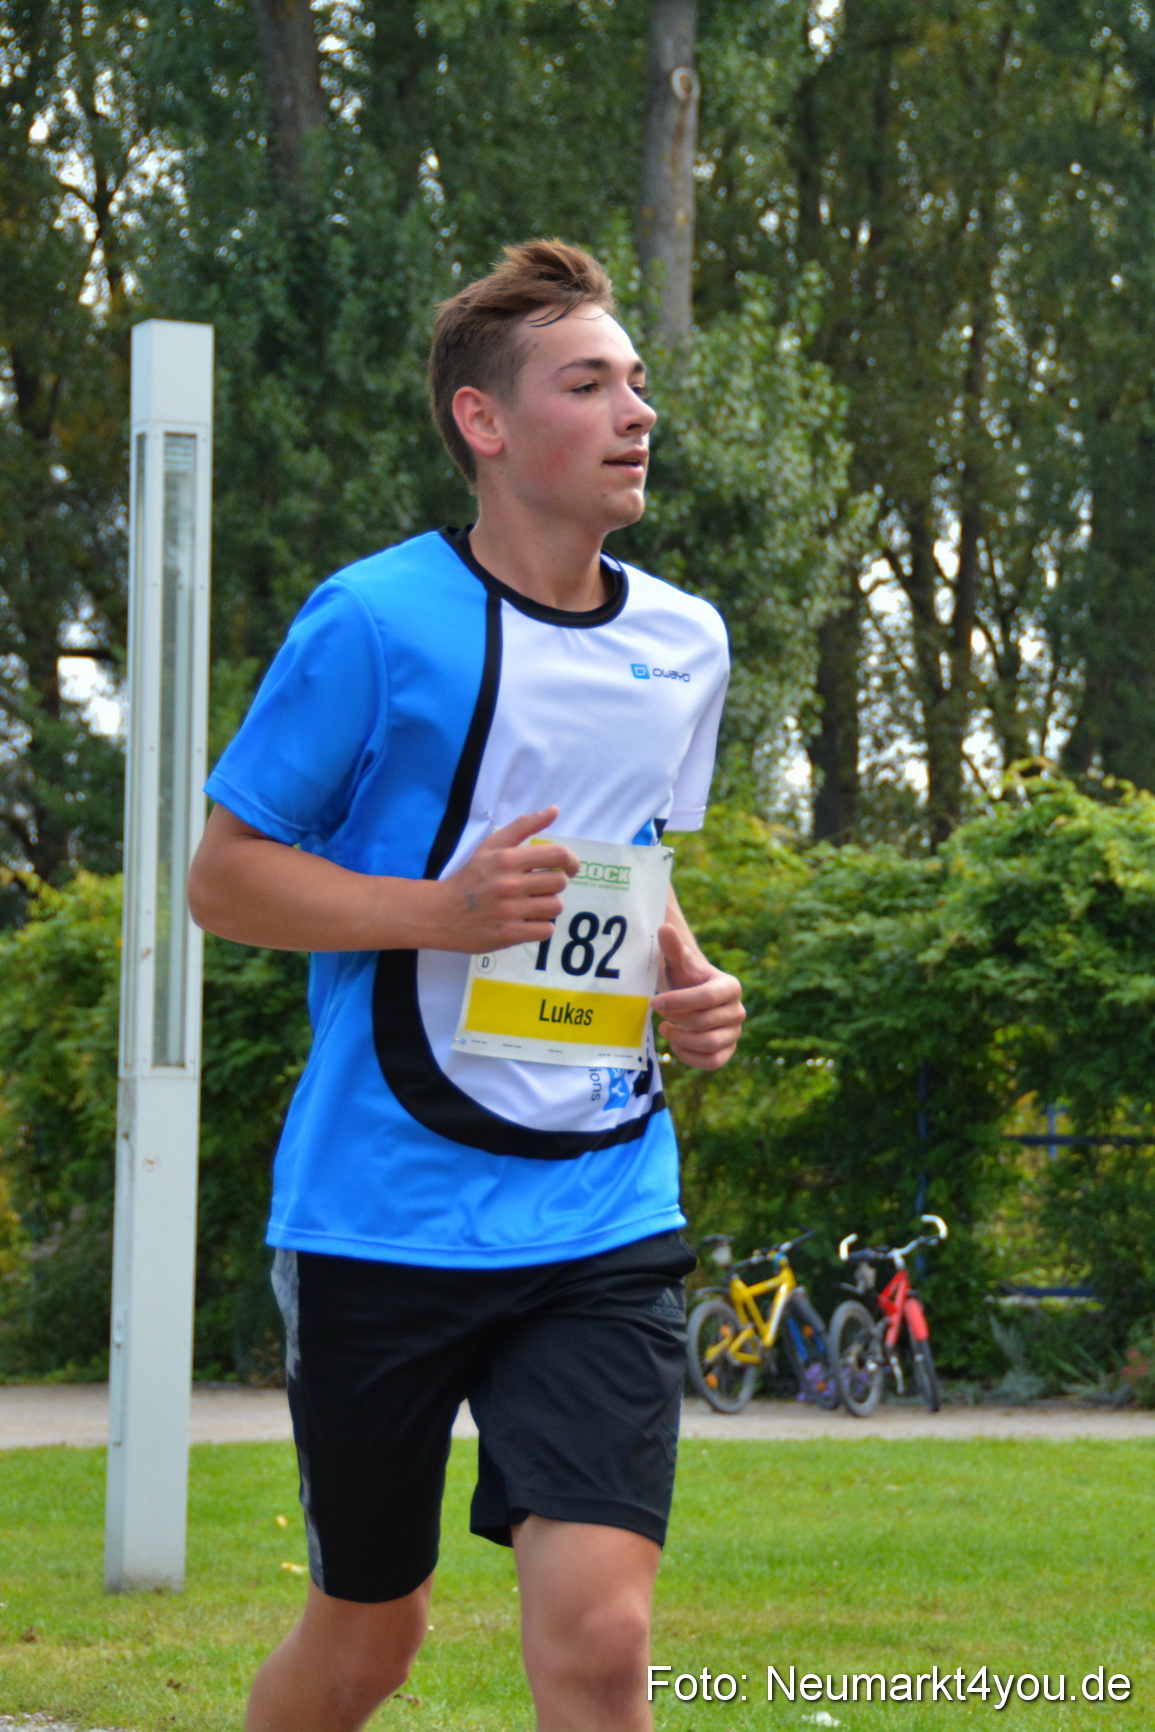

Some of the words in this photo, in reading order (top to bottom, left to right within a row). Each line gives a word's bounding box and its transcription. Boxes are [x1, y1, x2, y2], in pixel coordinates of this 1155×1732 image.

[535, 911, 628, 979] 182
[481, 956, 490, 968] D
[539, 999, 594, 1026] Lukas
